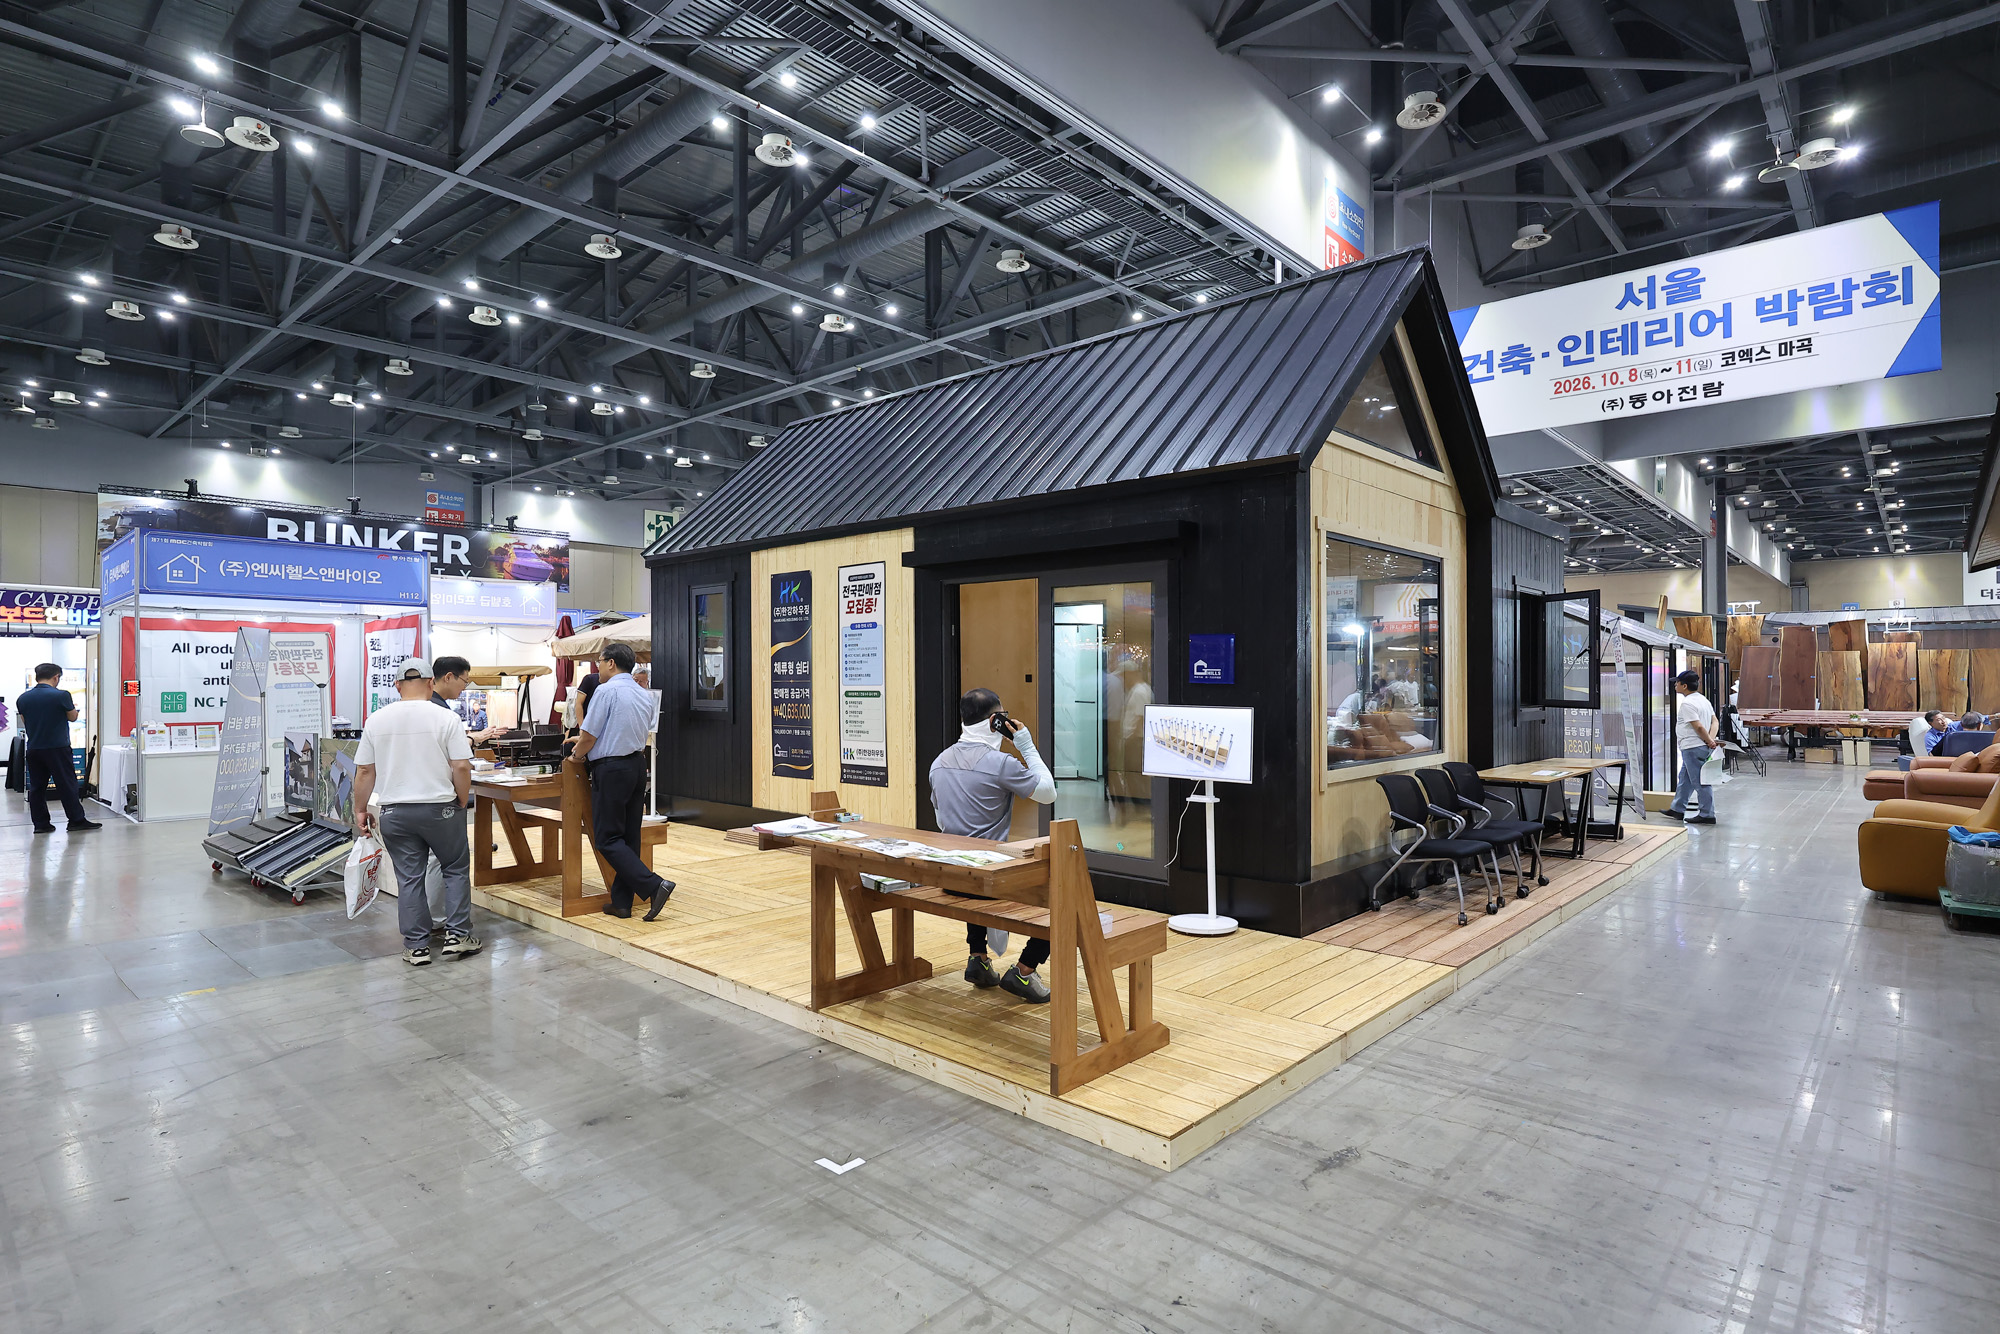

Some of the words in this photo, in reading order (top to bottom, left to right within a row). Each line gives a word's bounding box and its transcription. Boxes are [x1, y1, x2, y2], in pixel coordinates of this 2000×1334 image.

[1342, 250, 1358, 264] 소화
[1614, 266, 1707, 312] 서울
[1464, 302, 1733, 385] 건축·인테리어
[1754, 264, 1915, 327] 박람회
[1553, 376, 1596, 396] 2026.
[1601, 372, 1625, 390] 10.
[1720, 346, 1772, 368] 코엑스
[1778, 337, 1813, 358] 마곡
[267, 517, 472, 566] BUNKER
[219, 559, 384, 586] (주)엔씨헬스앤바이오
[399, 592, 420, 600] H112
[842, 582, 882, 599] 전국판매점
[846, 598, 878, 615] 모집중!
[171, 643, 190, 654] All
[774, 661, 794, 676] 체류형
[796, 660, 810, 675] 쉼터
[203, 675, 230, 686] anti
[194, 697, 215, 708] NC
[790, 688, 810, 700] 공급가격
[773, 703, 811, 722] ₩40,635,000
